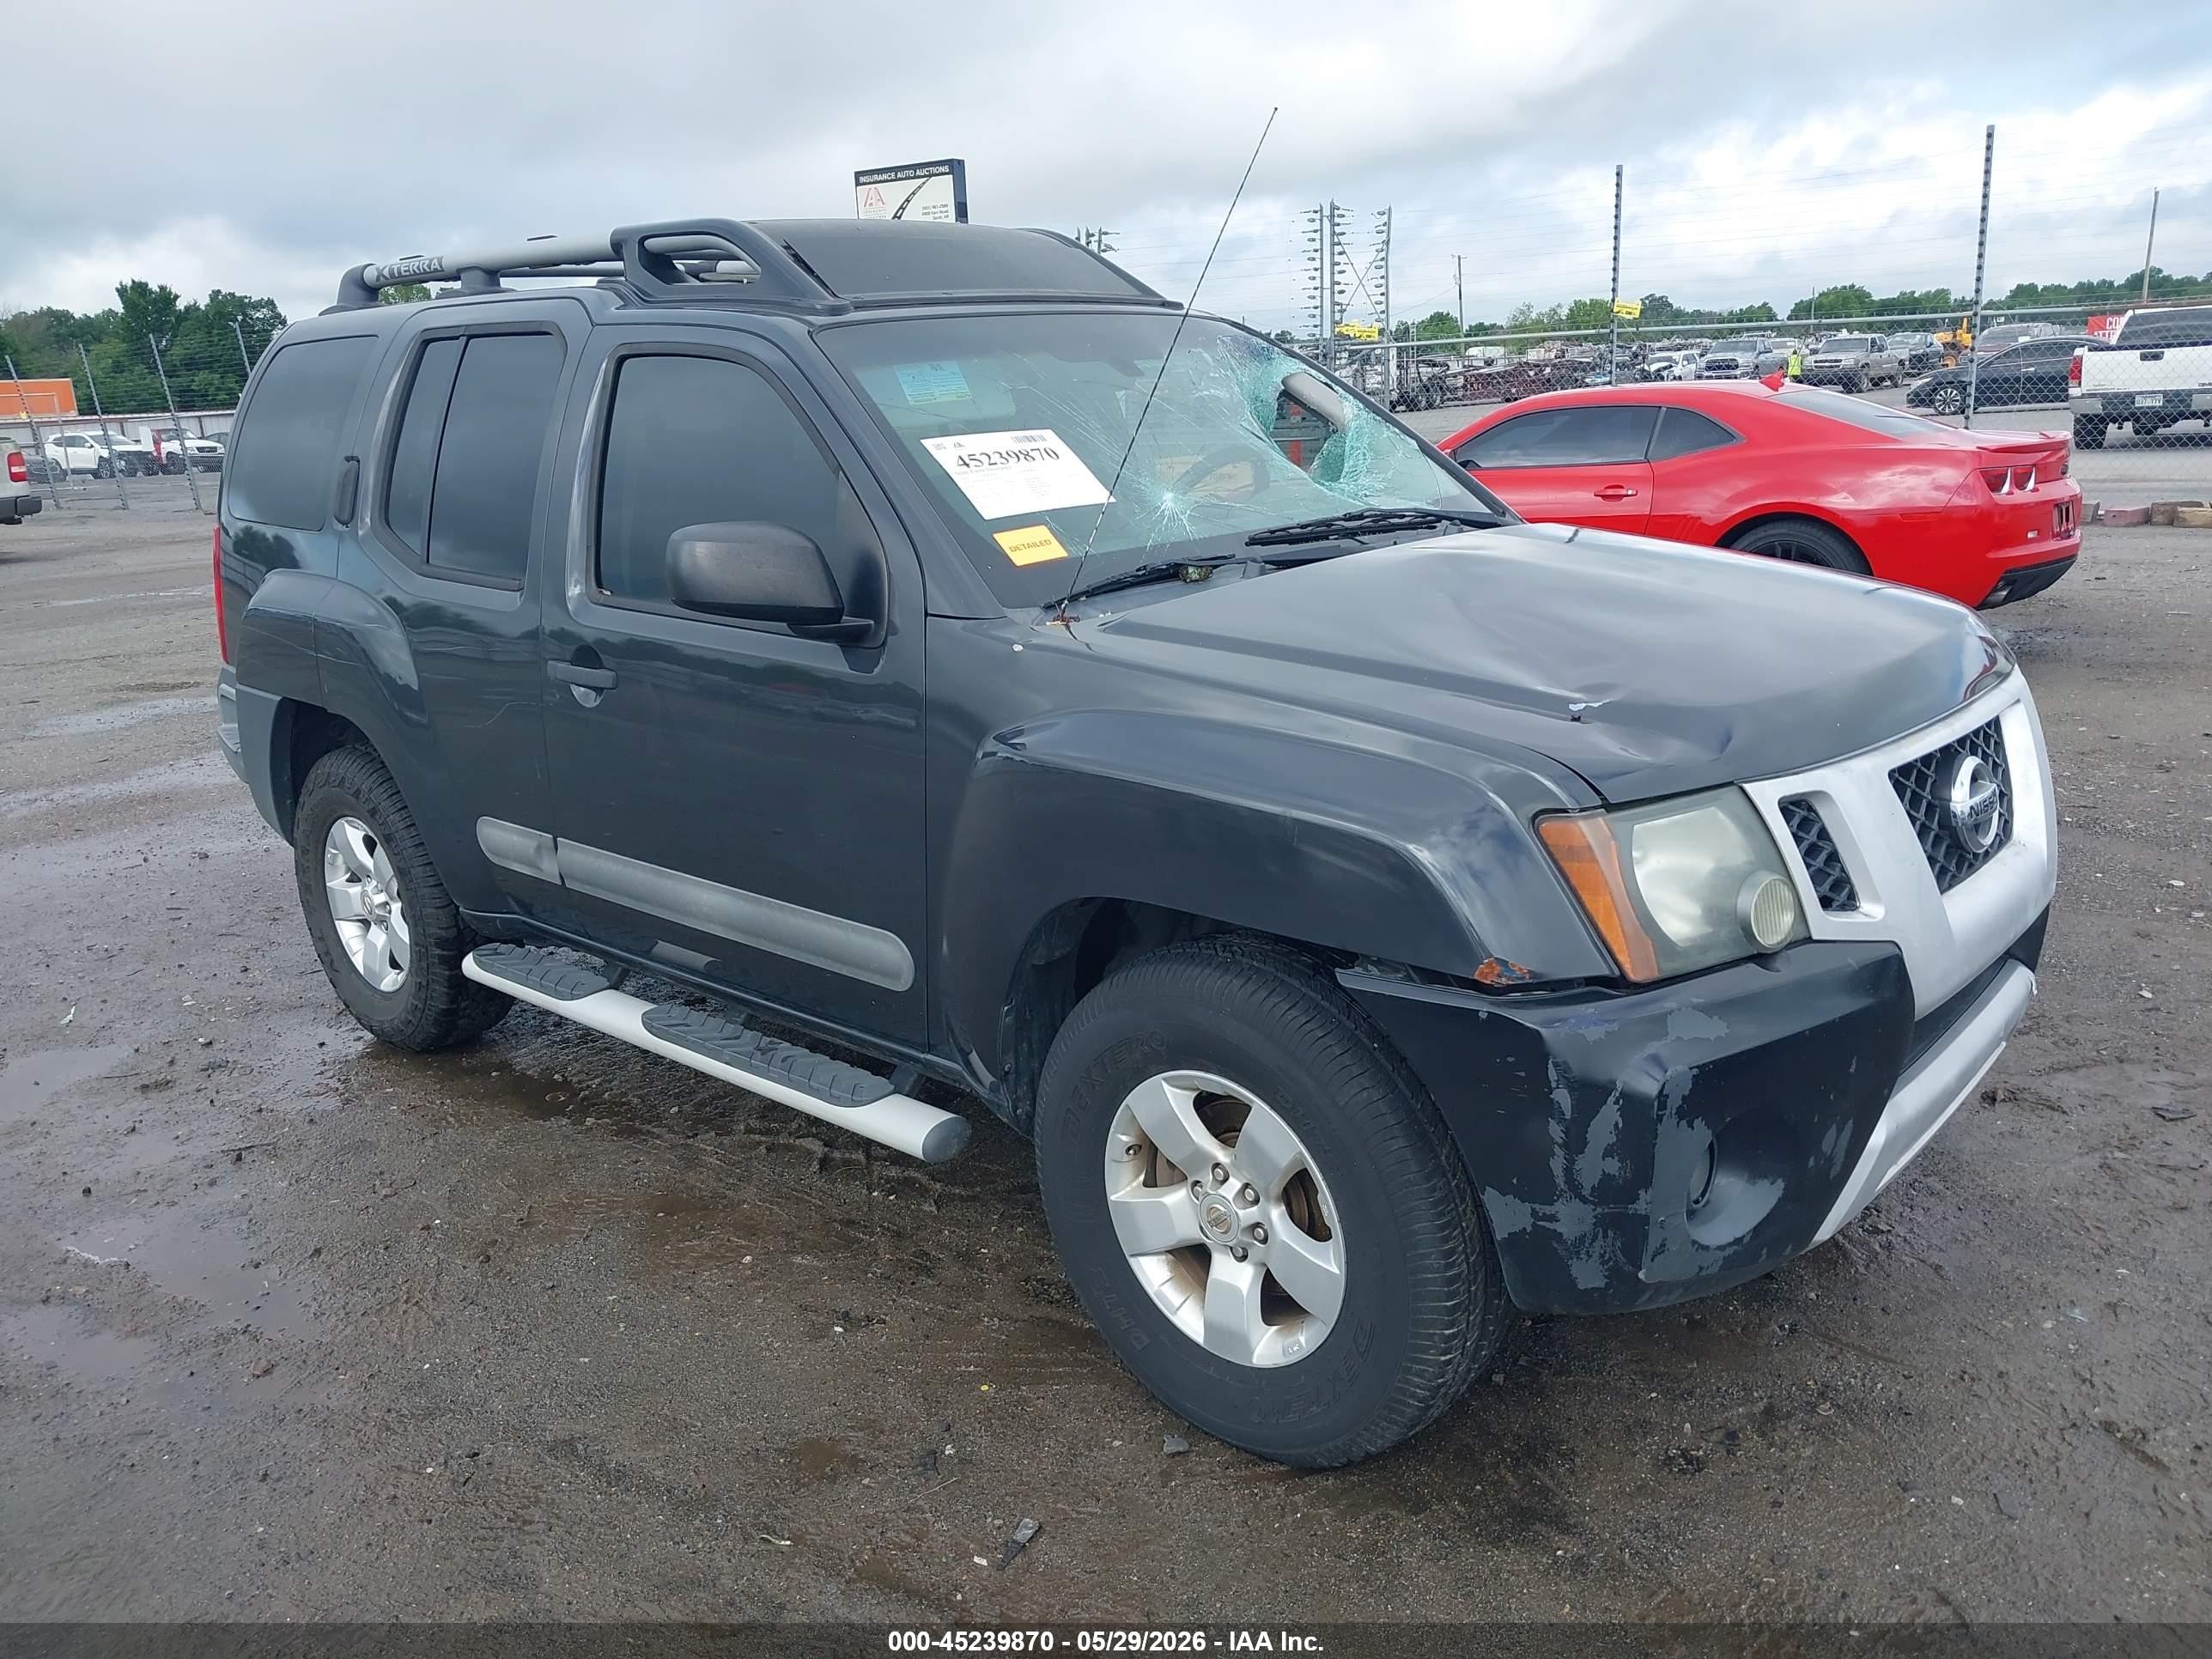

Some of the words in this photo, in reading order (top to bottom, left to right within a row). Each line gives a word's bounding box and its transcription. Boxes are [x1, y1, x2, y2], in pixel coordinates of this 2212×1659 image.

[859, 172, 896, 184] INSURANCE
[896, 170, 915, 179] AUTO
[915, 165, 950, 176] AUCTIONS
[375, 258, 442, 283] XTERRA
[957, 447, 1060, 468] 45239870
[1008, 538, 1052, 552] DETAILED
